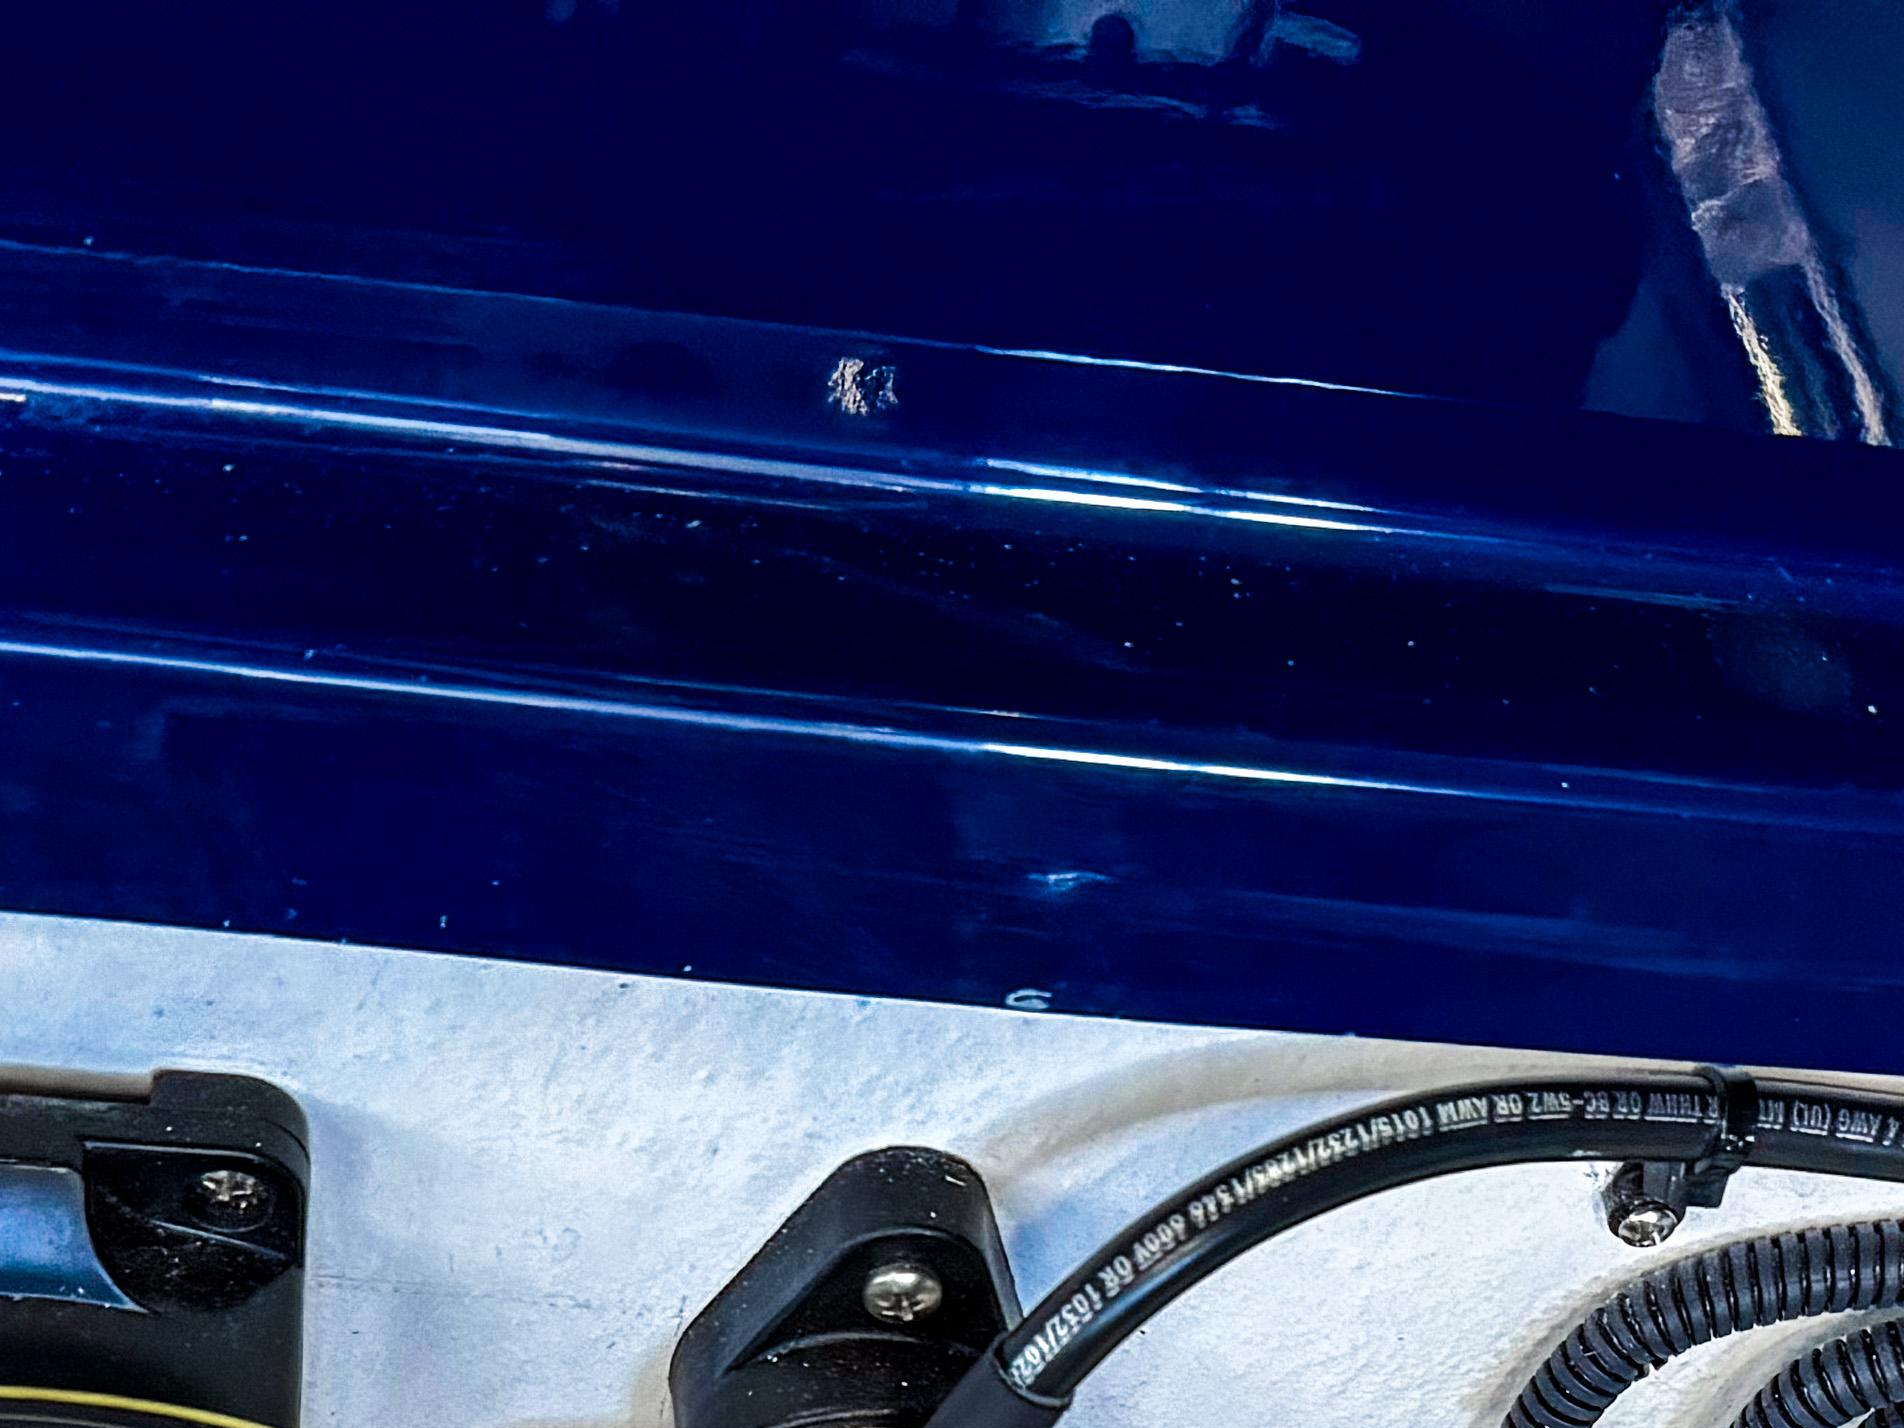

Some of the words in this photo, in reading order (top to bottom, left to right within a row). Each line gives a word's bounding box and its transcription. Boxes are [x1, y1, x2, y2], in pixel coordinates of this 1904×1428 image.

[1437, 1095, 1489, 1127] AWM
[1492, 1093, 1523, 1117] OR
[1612, 1090, 1643, 1114] OR
[1838, 1108, 1883, 1137] AWG
[1134, 1213, 1187, 1270] 600V
[1098, 1255, 1135, 1298] OR
